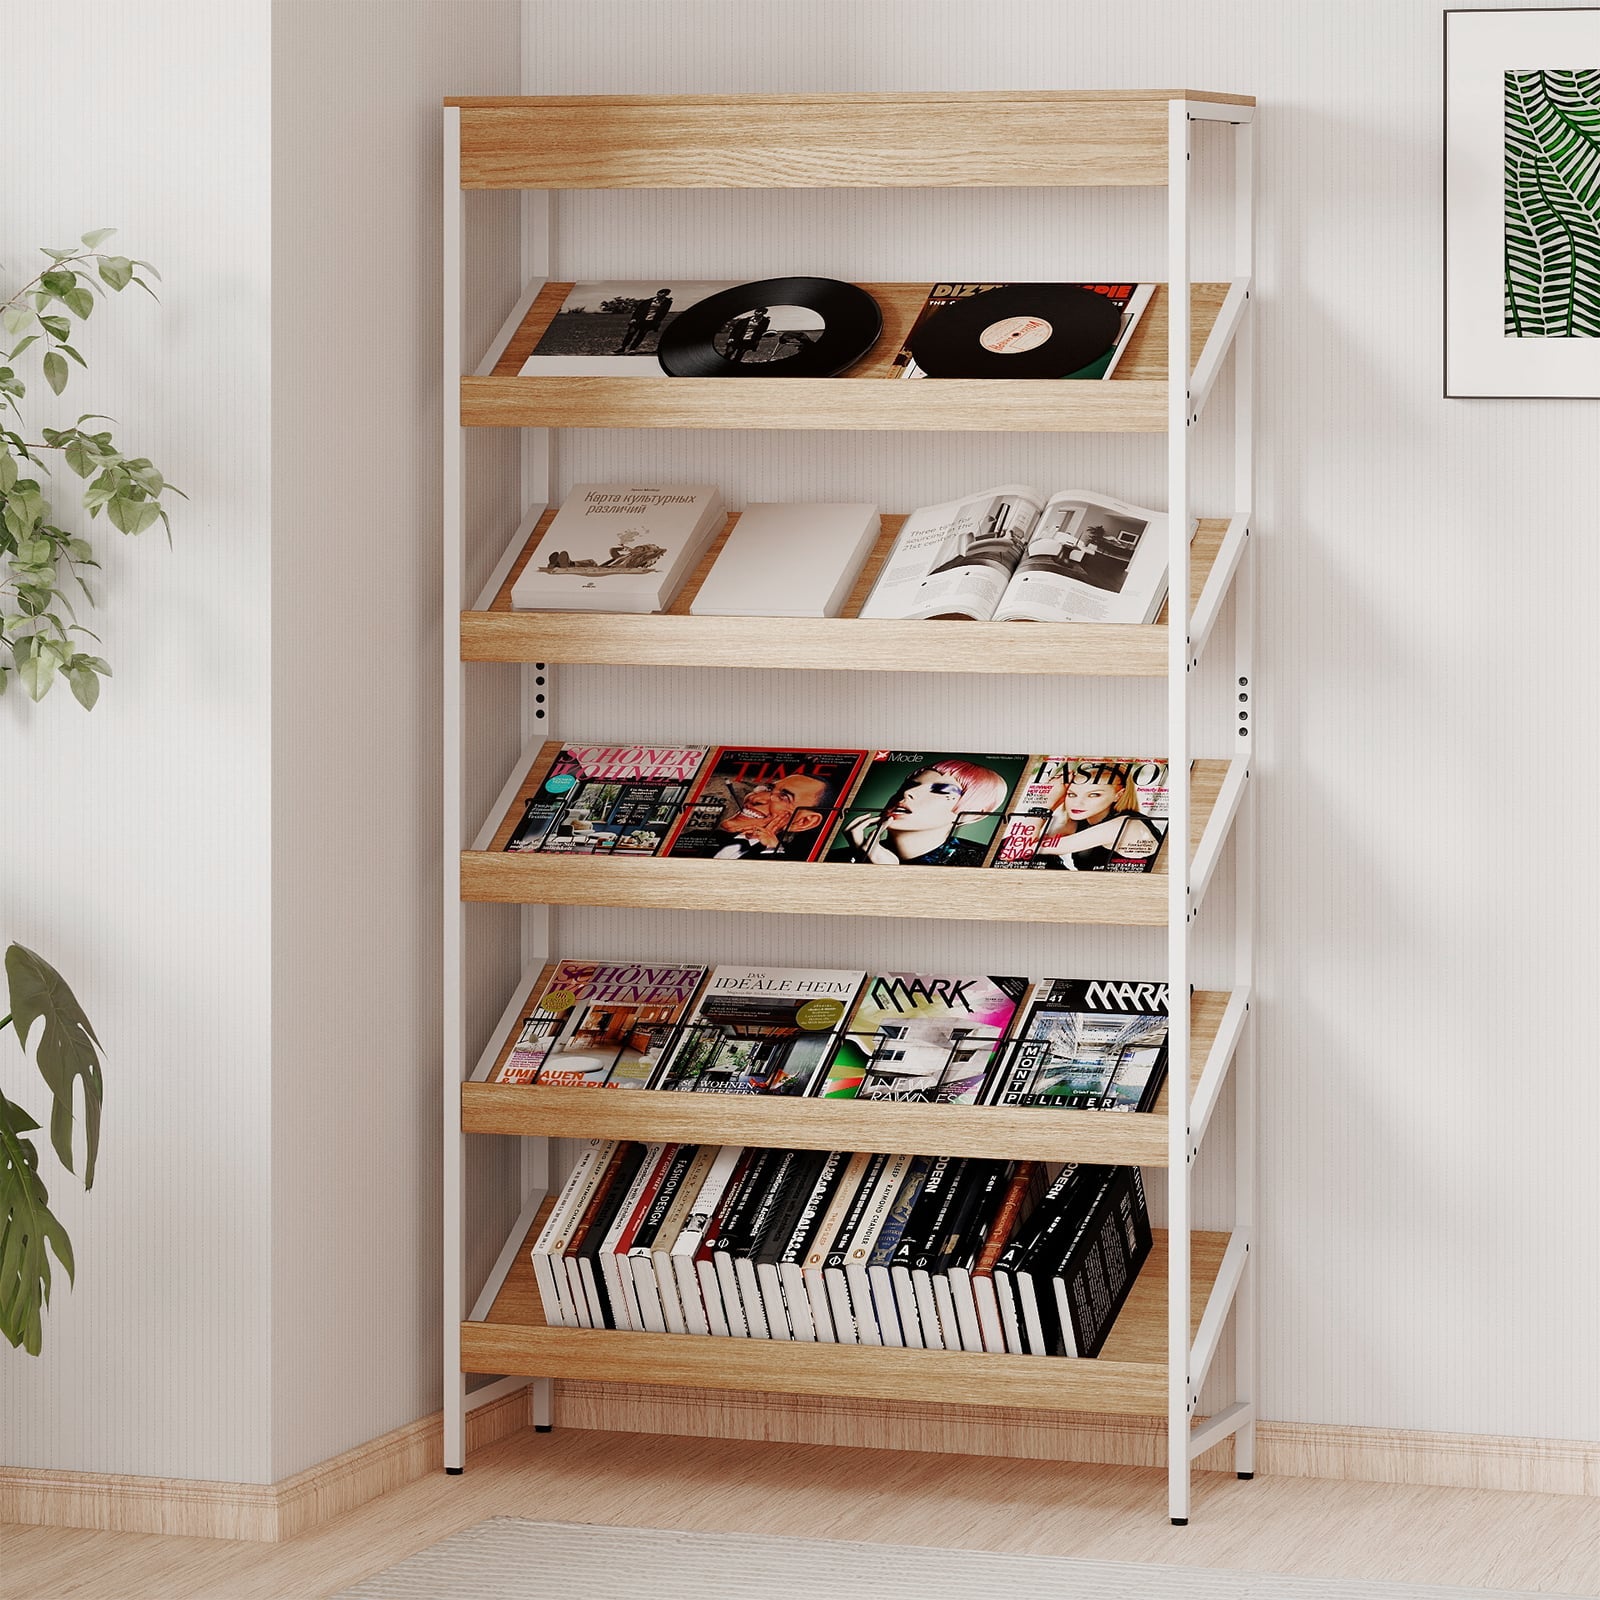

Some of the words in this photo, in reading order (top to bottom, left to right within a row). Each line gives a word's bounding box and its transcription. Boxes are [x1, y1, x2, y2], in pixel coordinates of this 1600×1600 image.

[932, 284, 1004, 298] DIZZ
[584, 491, 621, 504] Карта
[623, 494, 697, 506] культурных
[585, 504, 647, 515] различий
[906, 530, 946, 544] sourcing
[911, 528, 937, 537] Three
[559, 745, 702, 766] SCHÖNER
[887, 752, 924, 763] Mode
[550, 763, 694, 783] WOHNEN
[731, 762, 838, 783] TIME
[700, 795, 727, 804] The
[687, 820, 715, 828] Dea
[1010, 822, 1035, 836] the
[1003, 836, 1036, 848] new
[998, 847, 1035, 861] style
[555, 964, 701, 987] SCHÖNER
[714, 977, 793, 991] IDEALE
[796, 981, 853, 993] HEIM
[547, 983, 694, 1004] WOHNEN
[871, 977, 978, 1013] MARK
[1048, 995, 1063, 1003] 41
[1084, 981, 1168, 1012] MARK
[700, 1080, 755, 1090] WOHNEN
[877, 1078, 930, 1095] NEW
[637, 1146, 660, 1187] Conversations
[660, 1160, 670, 1177] GOES
[690, 1161, 705, 1188] HARRY
[770, 1152, 794, 1193] Conversations
[891, 1163, 904, 1179] SLEEP
[925, 1156, 950, 1194] ODERN
[652, 1177, 663, 1190] HERE
[663, 1160, 687, 1195] FASHION
[1046, 1163, 1078, 1200] ODERN
[578, 1182, 594, 1209] RAYMOND
[629, 1187, 639, 1200] with
[763, 1193, 774, 1207] with
[875, 1184, 893, 1213] RAYMOND
[615, 1201, 633, 1230] Architects
[648, 1195, 671, 1226] DESIGN
[672, 1189, 691, 1223] POTTER
[563, 1209, 580, 1236] CHANDLER
[749, 1207, 769, 1237] Architects
[861, 1215, 879, 1245] CHANDLER
